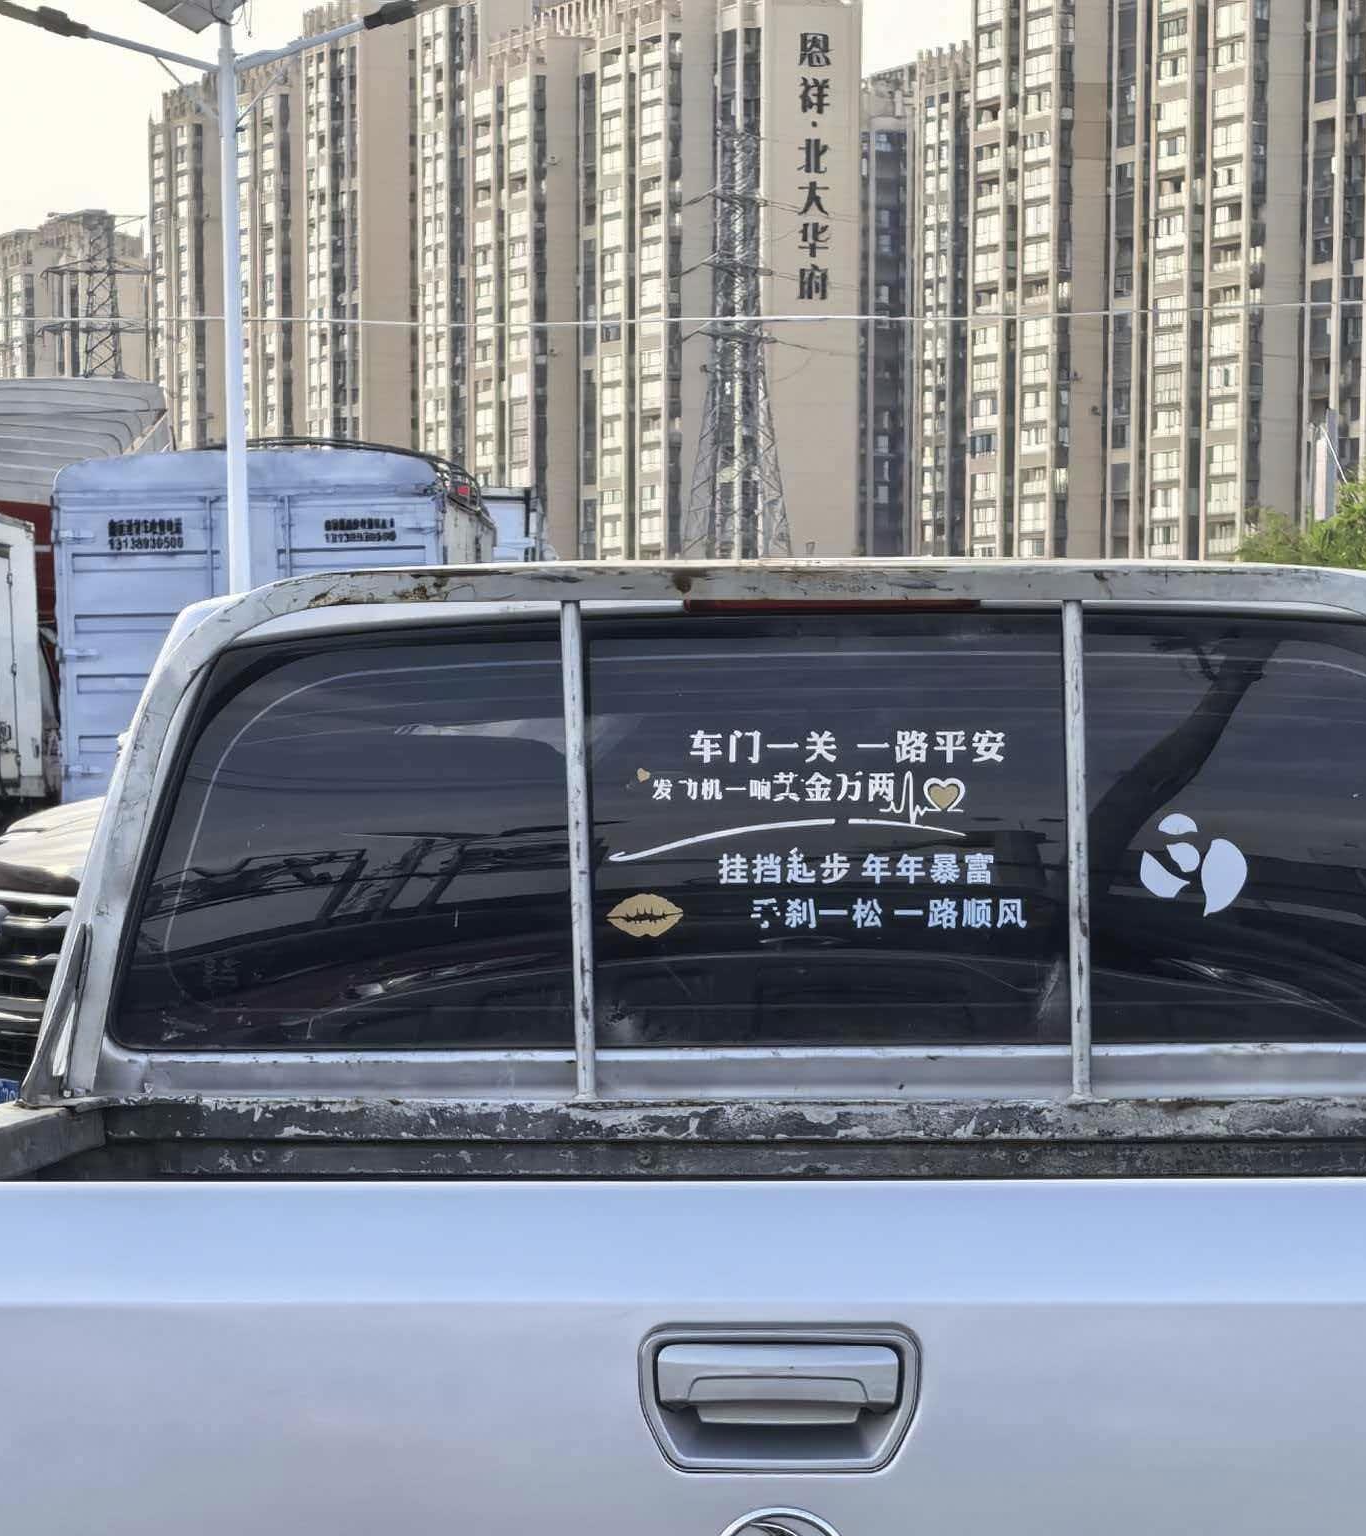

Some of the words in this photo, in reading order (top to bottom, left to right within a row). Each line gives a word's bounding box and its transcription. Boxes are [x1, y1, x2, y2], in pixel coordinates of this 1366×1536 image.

[795, 32, 832, 300] 恩祥·北大华府
[690, 730, 837, 764] 车门一关
[856, 730, 1005, 764] 一路平安
[718, 847, 851, 885] 挂挡起步
[861, 853, 994, 885] 年年暴富
[893, 897, 1028, 929] 一路顺风
